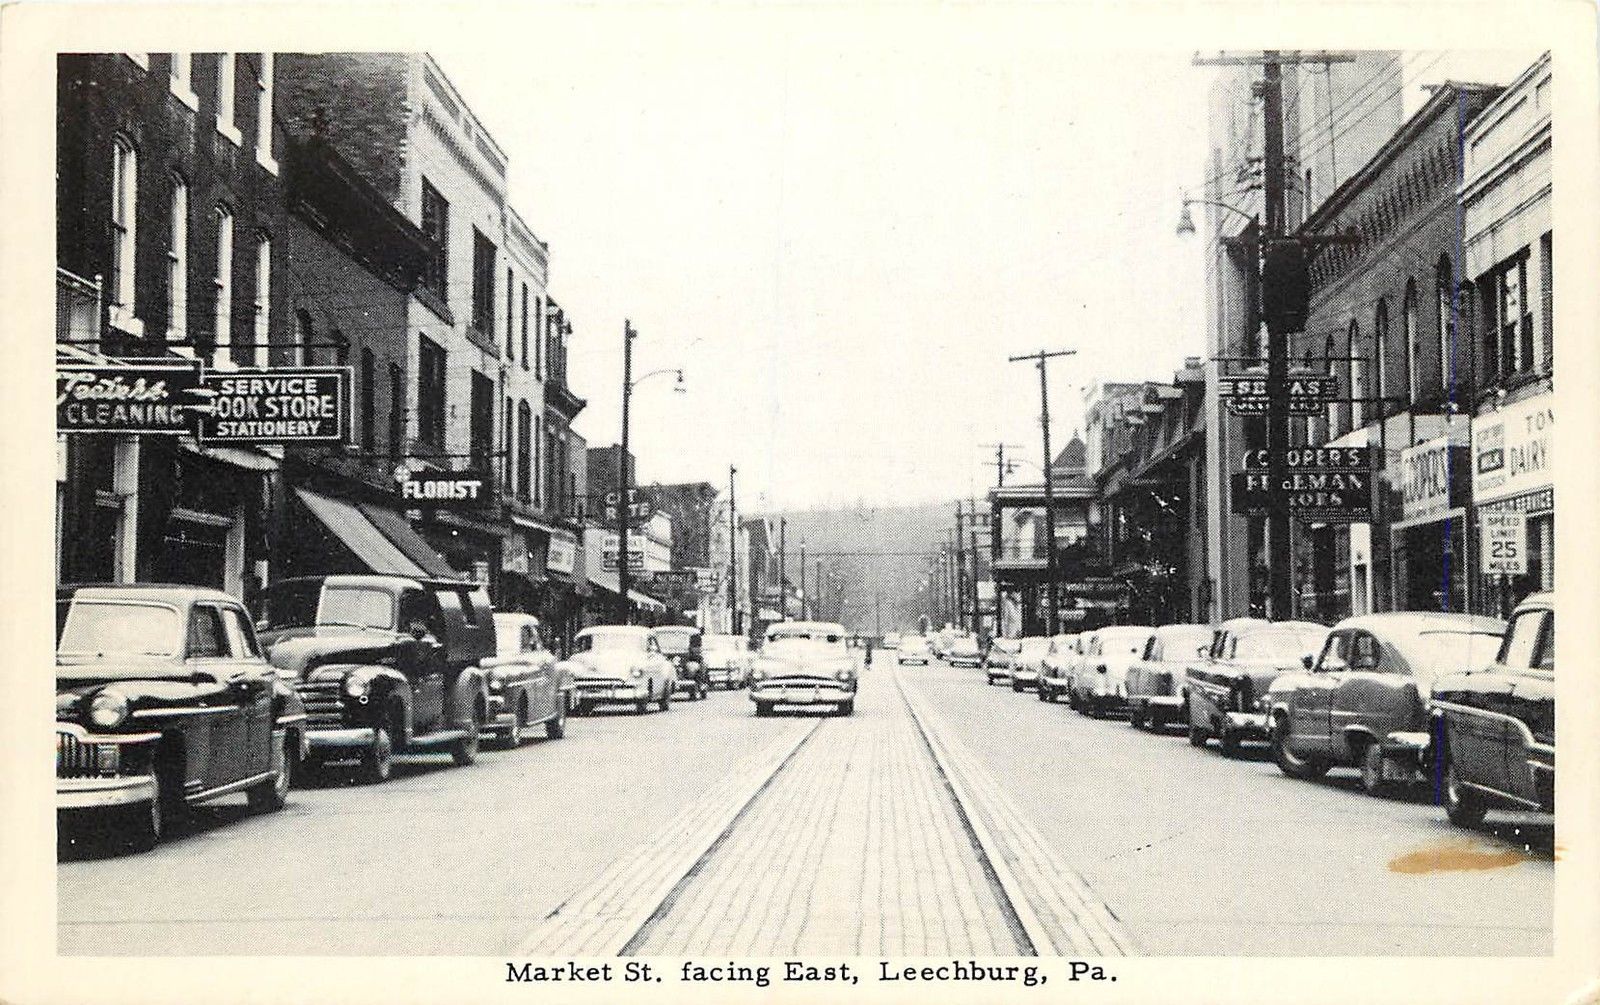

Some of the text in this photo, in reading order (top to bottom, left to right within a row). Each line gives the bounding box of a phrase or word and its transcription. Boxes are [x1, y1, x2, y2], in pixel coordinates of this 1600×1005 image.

[220, 379, 317, 395] SERVICE
[66, 403, 185, 425] CLEANING
[265, 395, 334, 418] STORE
[217, 421, 321, 436] STATIONERY
[1257, 448, 1361, 466] COPER'S
[1510, 438, 1548, 476] DAIRY
[402, 481, 482, 500] FLORIST
[605, 502, 650, 521] RTE
[1487, 515, 1520, 526] SPEED
[1491, 528, 1517, 539] LIMIT
[1491, 541, 1517, 558] 25
[1489, 561, 1520, 571] MILES
